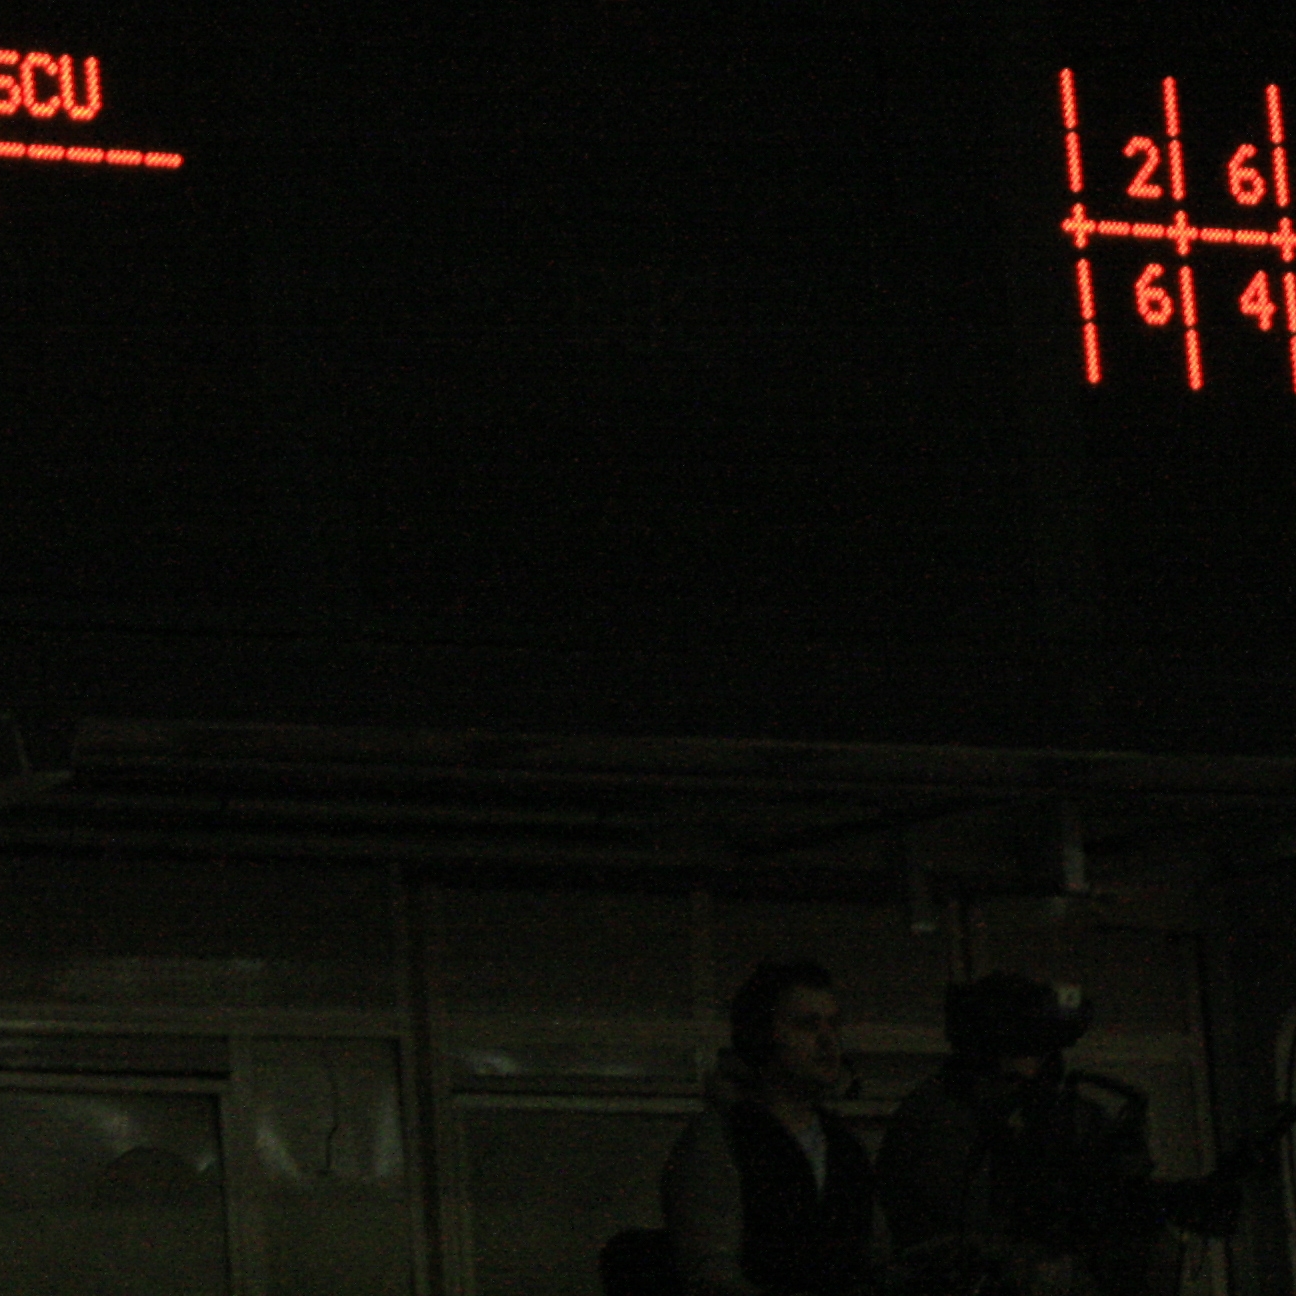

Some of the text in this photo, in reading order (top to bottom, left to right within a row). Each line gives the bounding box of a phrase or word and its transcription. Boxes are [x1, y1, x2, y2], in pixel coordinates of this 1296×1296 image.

[1122, 135, 1164, 199] 2
[1227, 143, 1266, 206] 6
[1133, 262, 1174, 326] 6
[1238, 270, 1278, 332] 4
